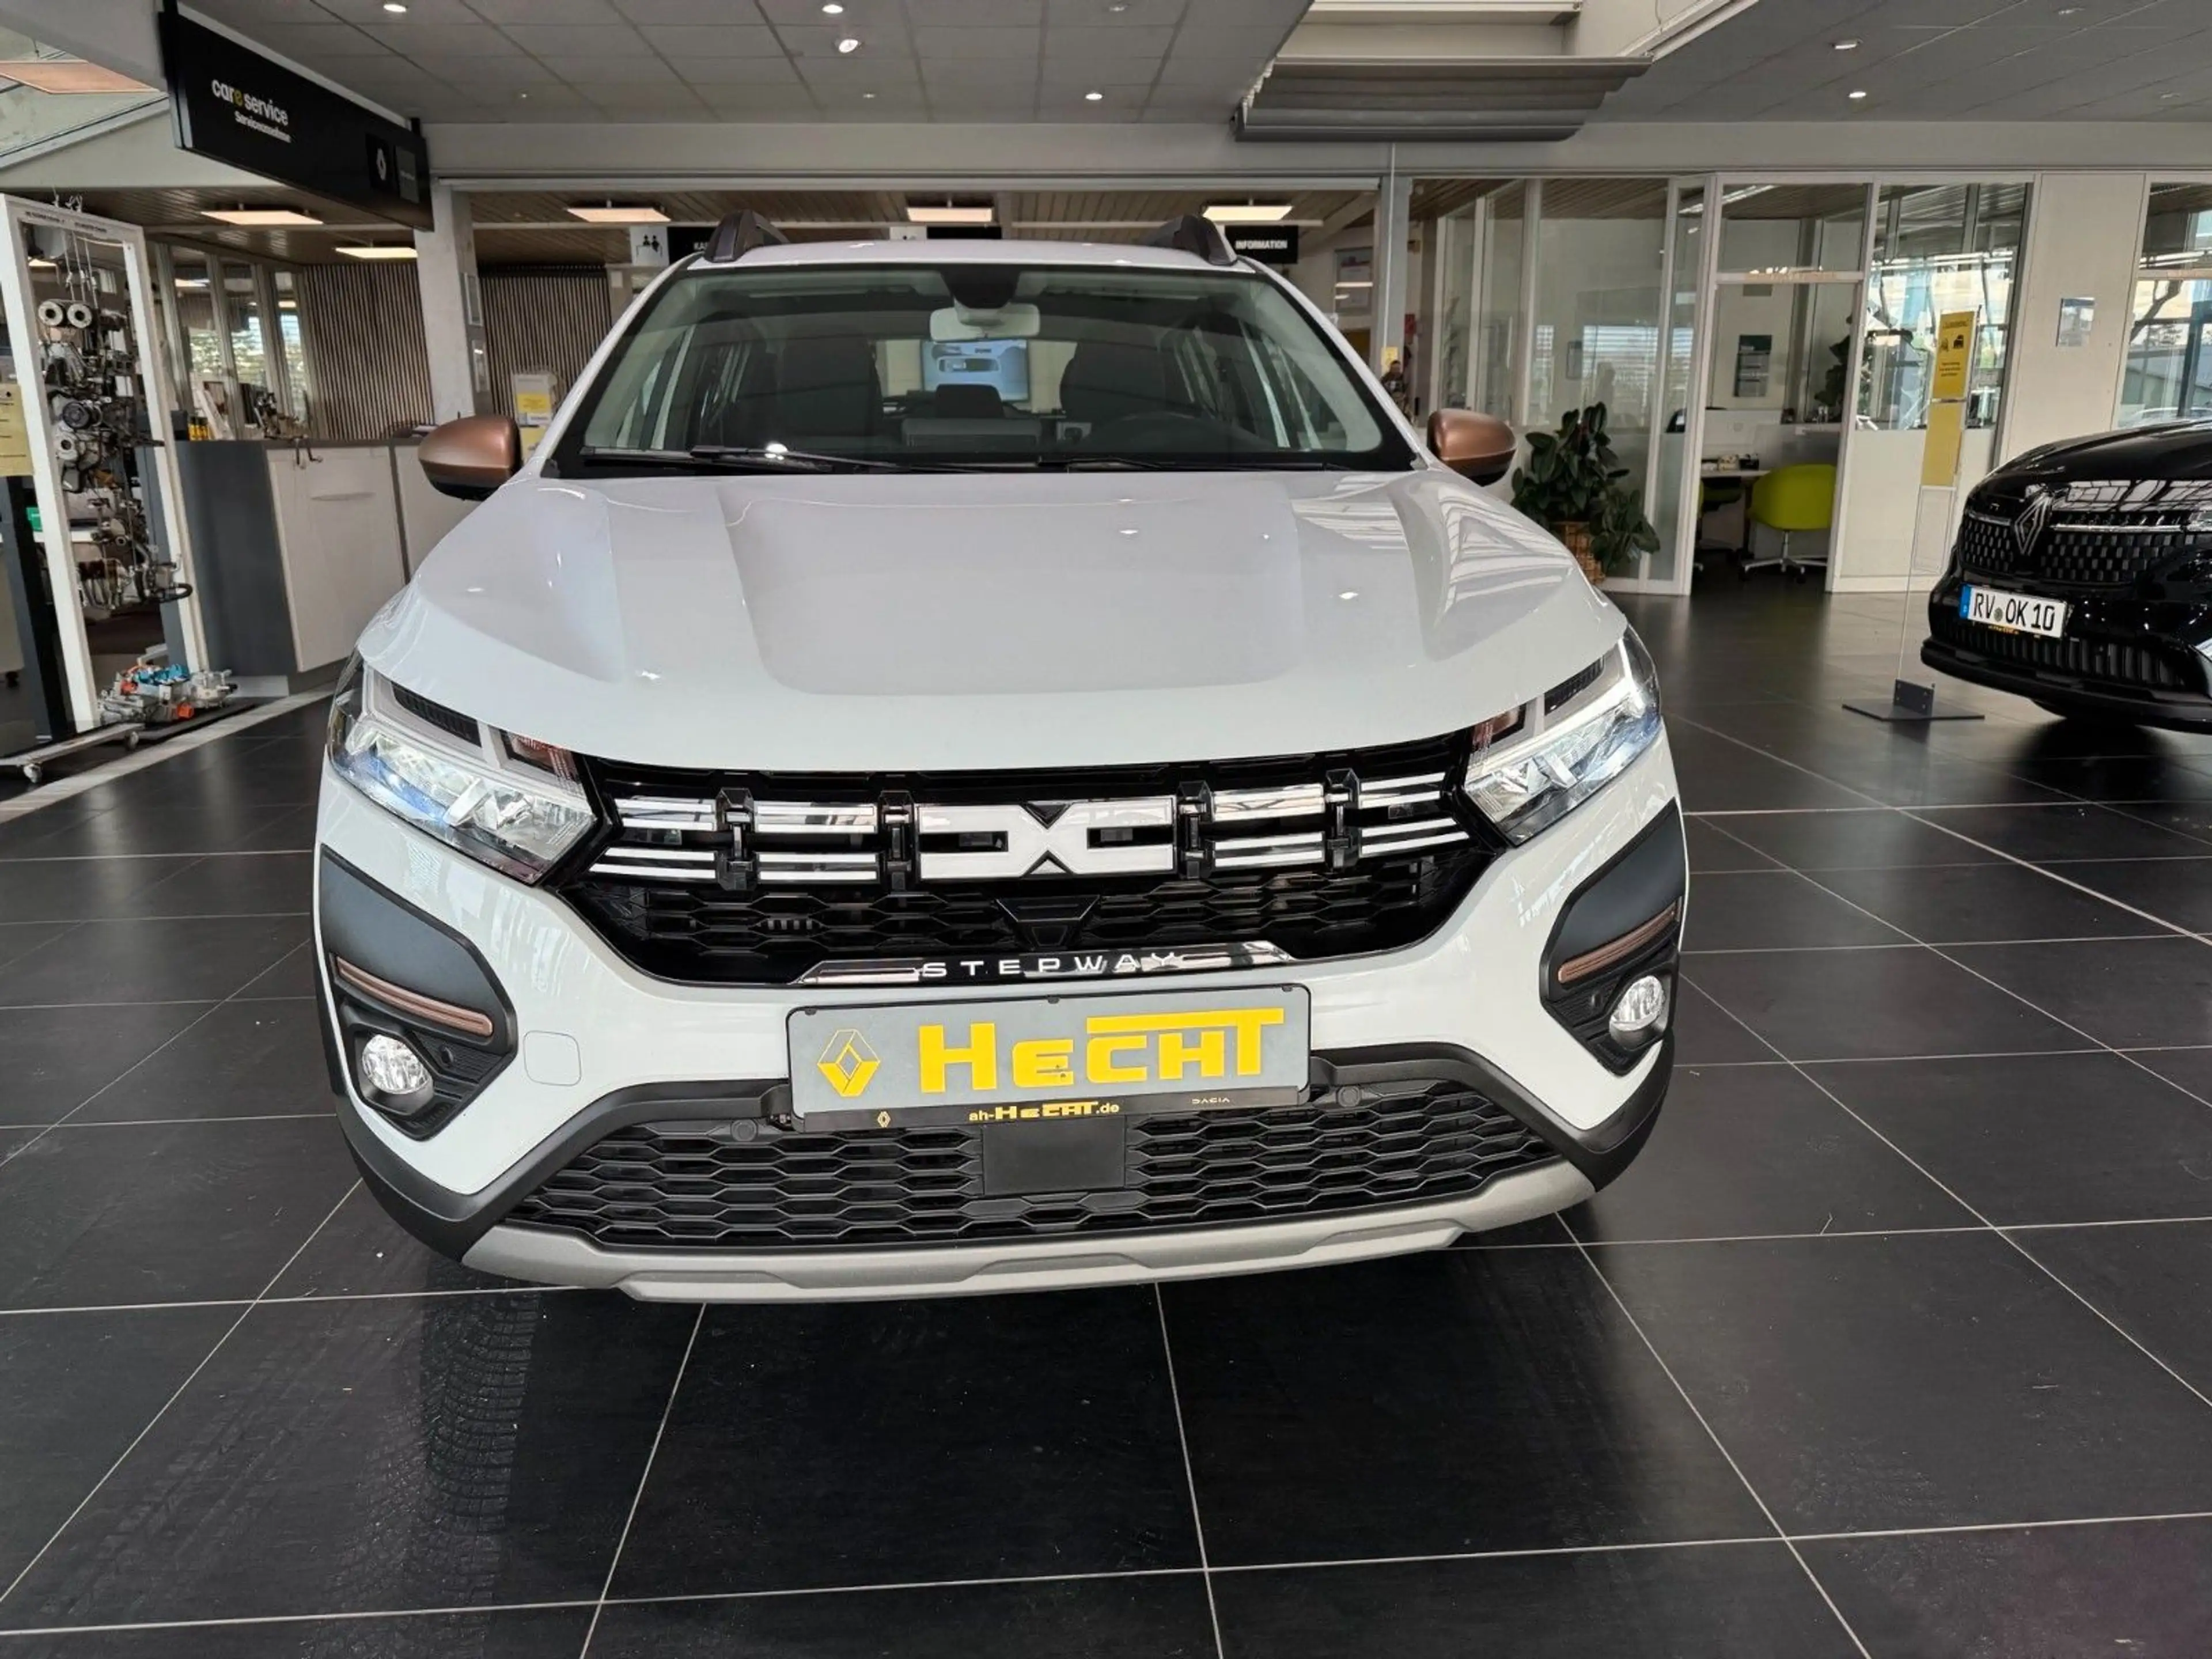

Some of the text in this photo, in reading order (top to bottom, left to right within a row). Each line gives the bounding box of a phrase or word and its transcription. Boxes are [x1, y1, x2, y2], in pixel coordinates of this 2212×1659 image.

[244, 93, 289, 126] service
[1235, 240, 1288, 249] INFORMATION
[1974, 593, 2055, 631] RV OK 10
[922, 952, 1176, 977] STEPWAY
